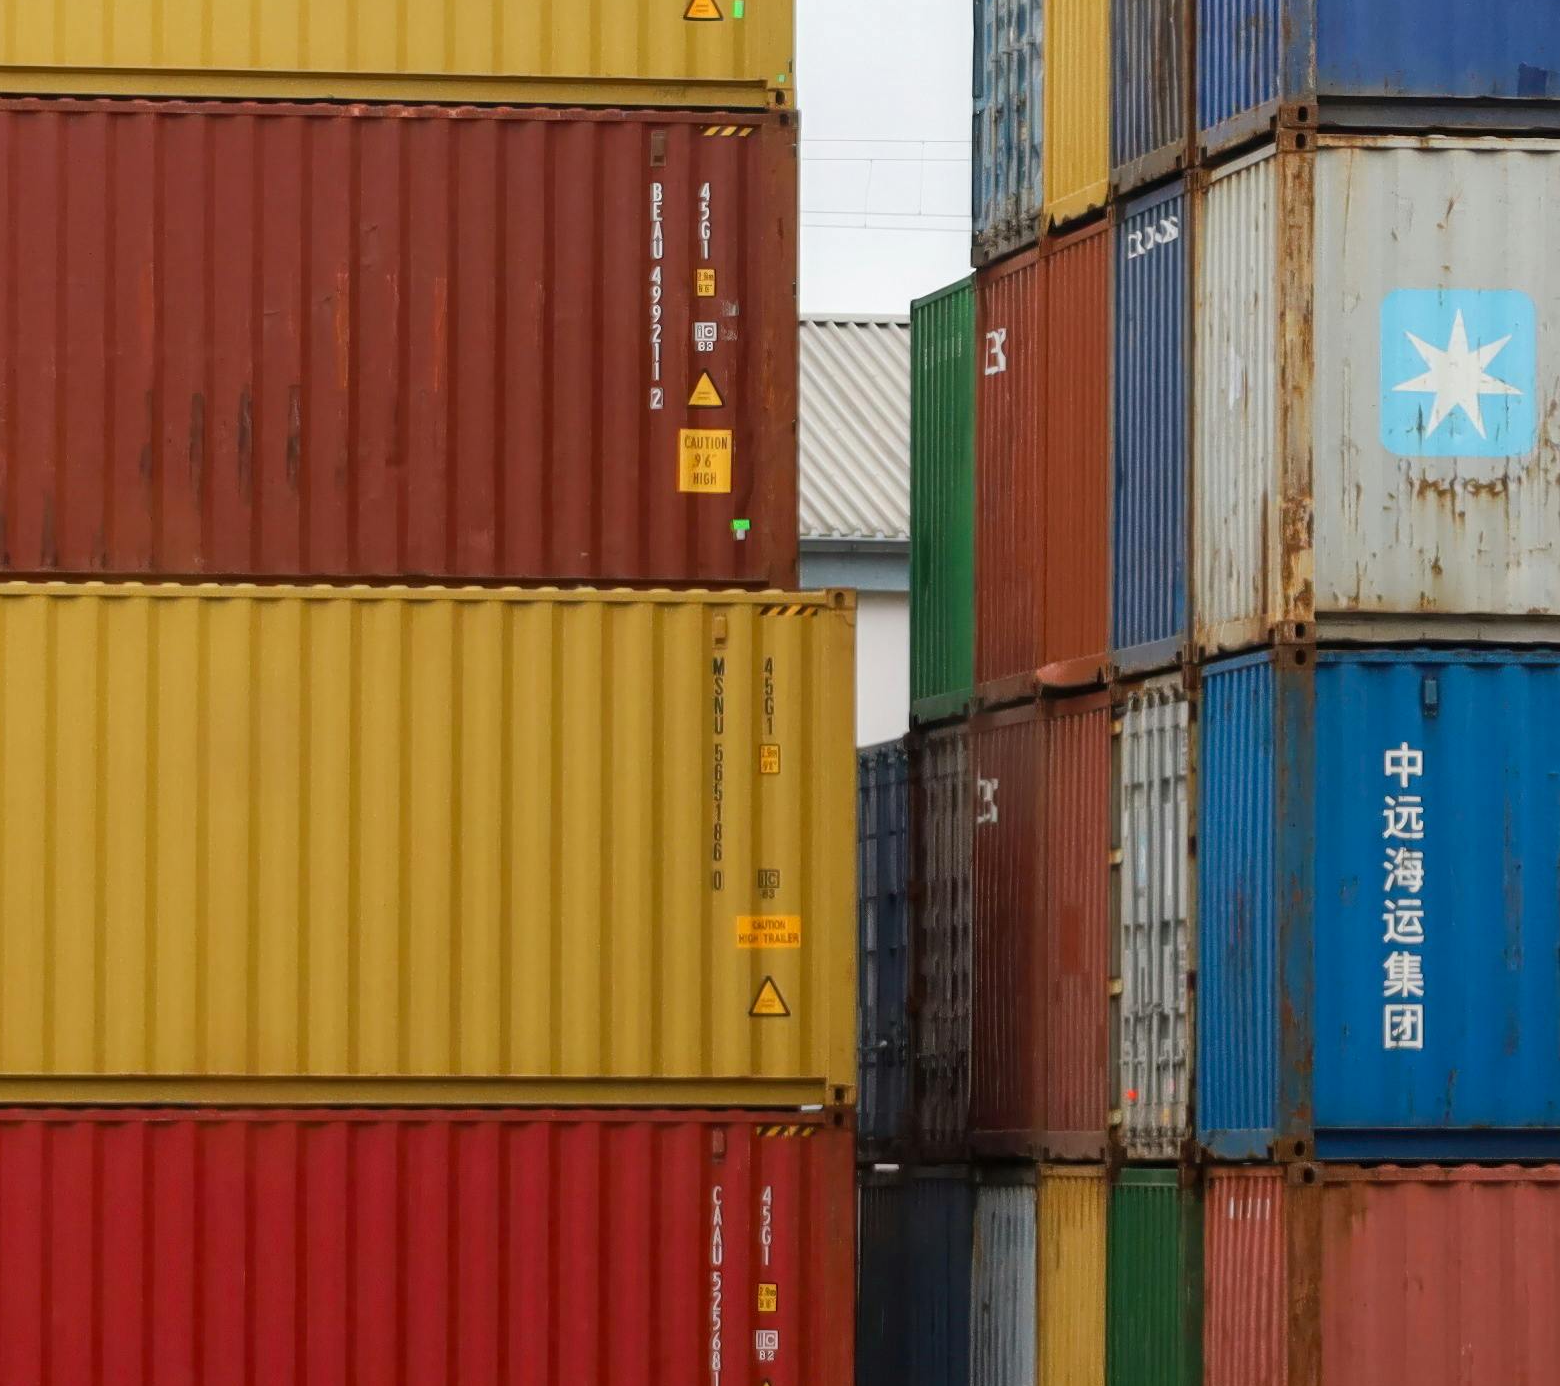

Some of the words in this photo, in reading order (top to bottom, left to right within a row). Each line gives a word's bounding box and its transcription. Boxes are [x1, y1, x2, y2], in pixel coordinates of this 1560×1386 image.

[650, 183, 663, 259] BEAU
[699, 183, 711, 259] 45G1
[649, 266, 662, 381] 499211
[650, 388, 662, 408] 2
[684, 436, 728, 450] CAUTION
[692, 472, 717, 486] HIGH
[712, 657, 725, 735] MSNU
[764, 657, 775, 735] 45G1
[713, 744, 723, 862] 565186
[752, 920, 785, 931] CAUTION
[1383, 743, 1425, 1052] 中远海运集团
[738, 933, 759, 944] HIGH
[763, 933, 799, 944] TRAILER
[712, 1186, 723, 1266] CAAU
[761, 1185, 772, 1266] 45G1
